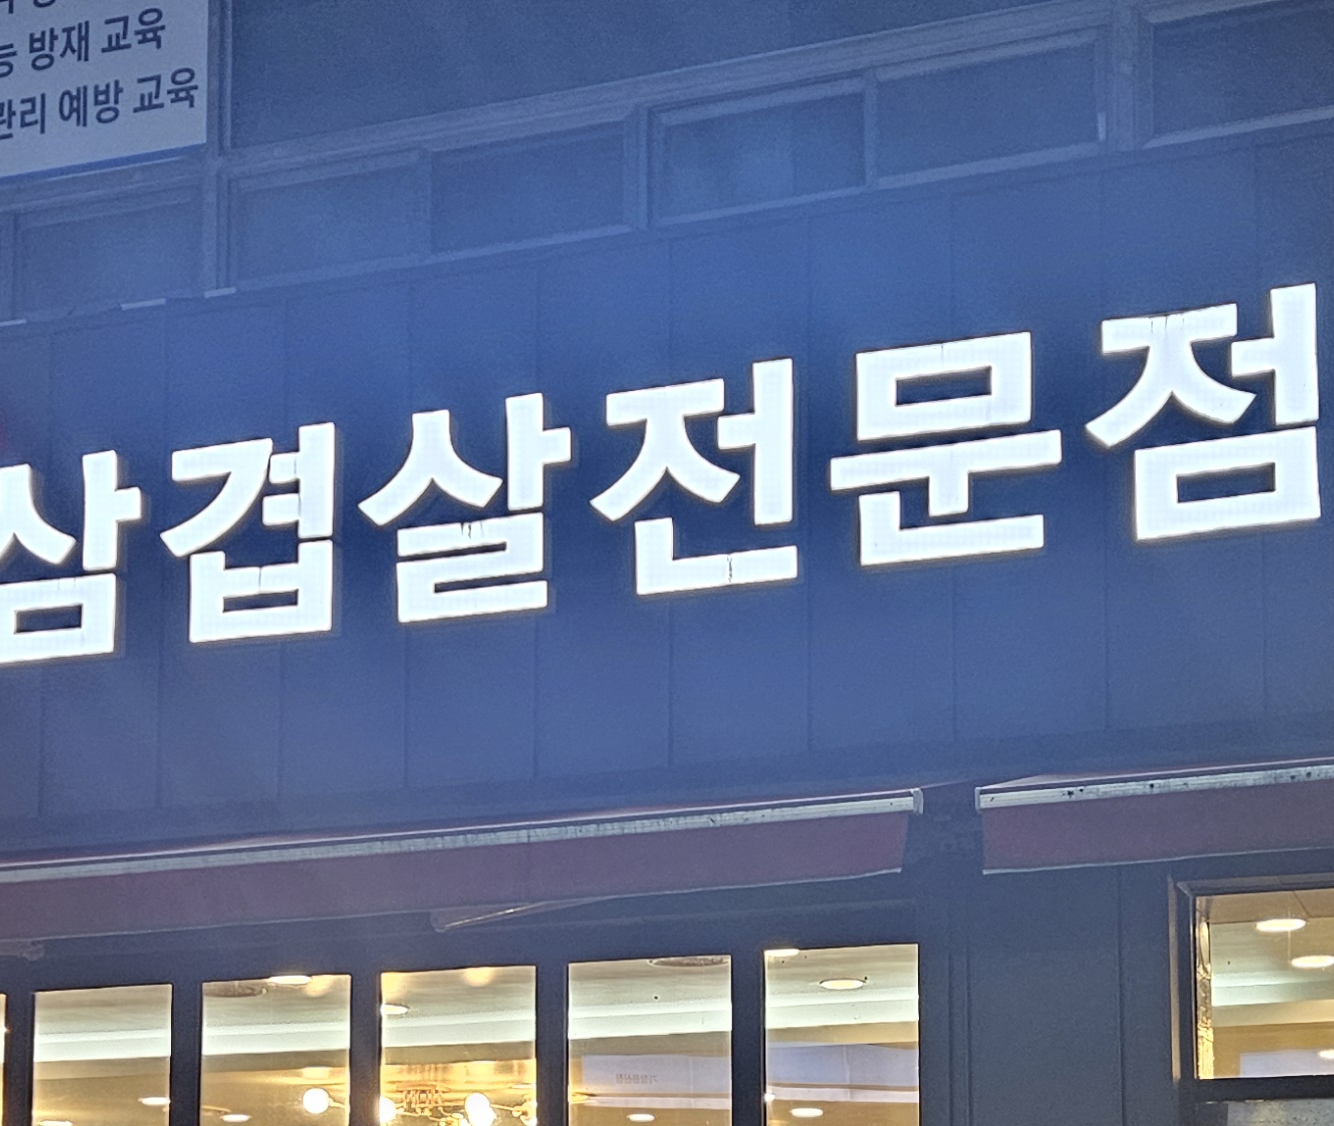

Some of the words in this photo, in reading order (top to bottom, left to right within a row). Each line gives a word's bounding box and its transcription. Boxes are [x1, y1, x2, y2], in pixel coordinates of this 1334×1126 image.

[28, 20, 91, 71] 방재
[101, 7, 166, 54] 교육
[58, 79, 124, 127] 예방
[132, 67, 199, 114] 교육
